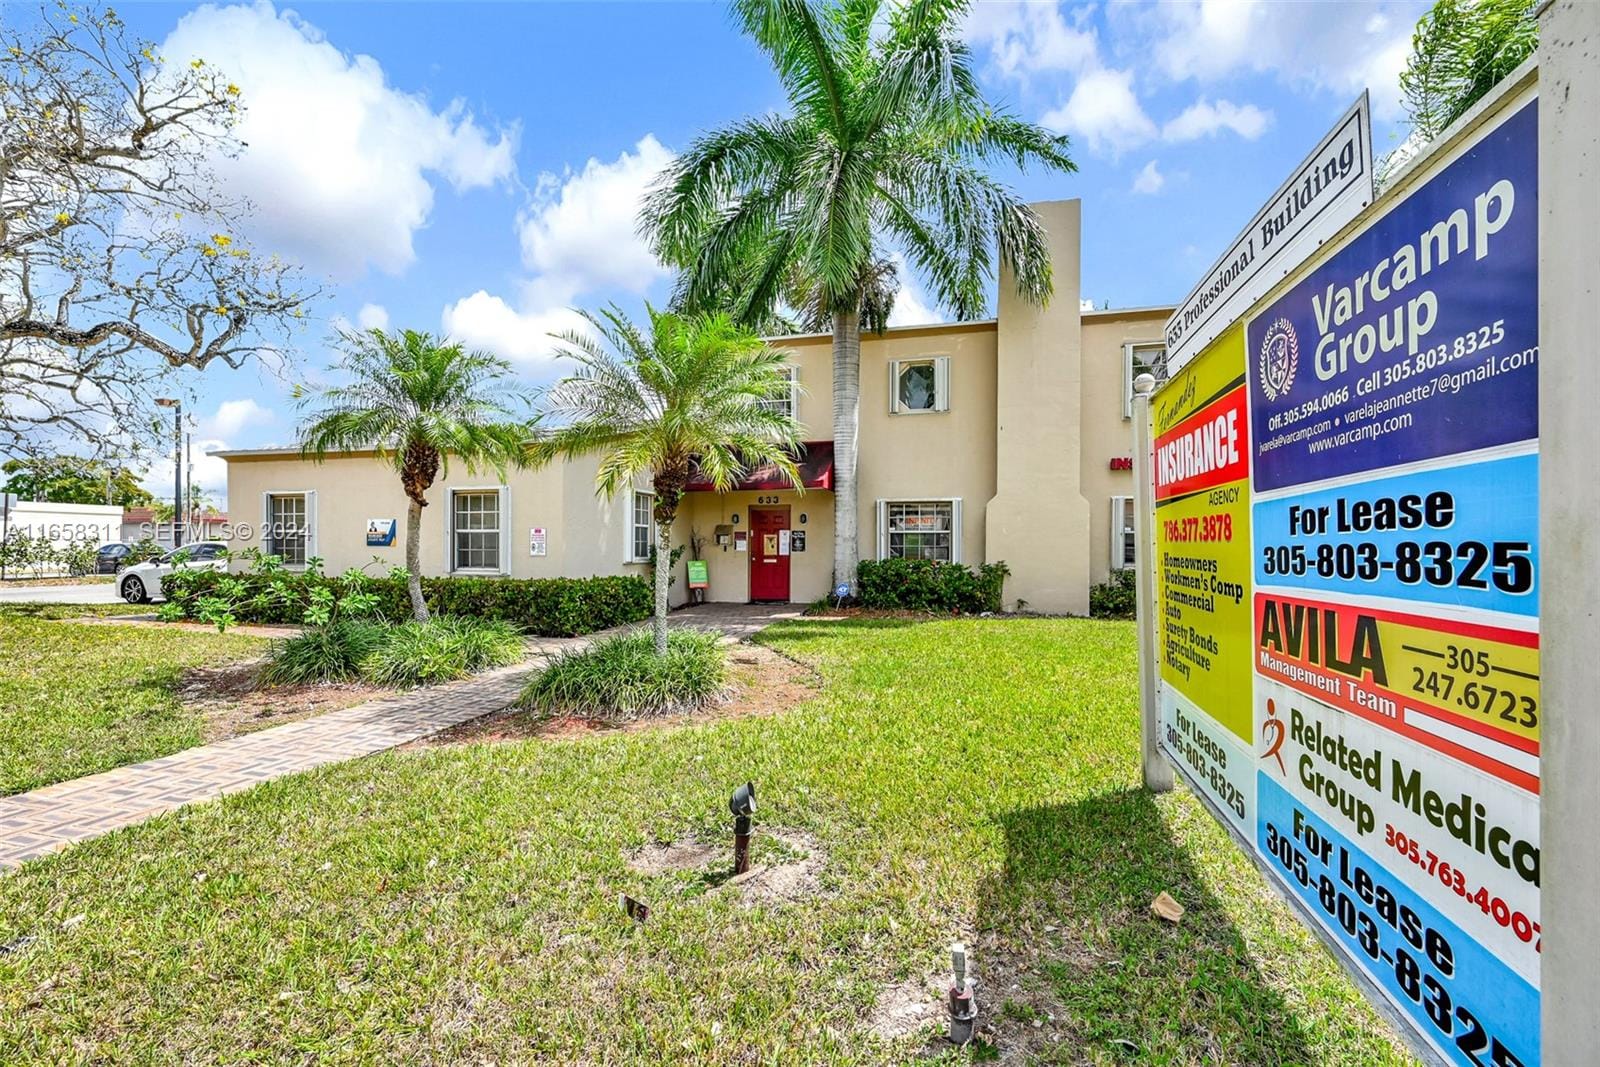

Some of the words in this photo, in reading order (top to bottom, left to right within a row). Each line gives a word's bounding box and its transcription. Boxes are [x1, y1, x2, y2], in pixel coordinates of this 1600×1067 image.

[1184, 238, 1255, 331] Professional
[1261, 138, 1354, 251] Building
[1312, 179, 1514, 336] Varcamp
[1314, 290, 1438, 381] Group
[1356, 370, 1380, 397] Cell
[1383, 319, 1505, 387] 305.803.8325
[1259, 420, 1331, 456] jvarela@varcamp.com
[1344, 346, 1539, 424] varelajeannette7@gmail.com
[1158, 408, 1239, 487] INSURANCE
[1308, 412, 1413, 454] www.varcamp.com
[758, 496, 779, 504] 633
[1208, 487, 1240, 506] AGENCY
[1289, 505, 1329, 536] For
[1336, 491, 1455, 534] Lease
[1163, 513, 1233, 544] 786.377.3878
[1164, 552, 1217, 573] Homeowners
[1164, 569, 1208, 591] Workmen's
[1210, 575, 1243, 604] Comp
[1263, 540, 1533, 595] 305-803-8325
[1165, 585, 1215, 613] Commercial
[1165, 601, 1181, 620] Auto
[1165, 617, 1188, 645] Surety
[1189, 626, 1218, 655] Bonds
[1166, 634, 1211, 671] Agriculture
[1260, 599, 1389, 688] AVILA
[1446, 645, 1490, 677] 305
[1166, 649, 1191, 682] Notary
[1259, 651, 1341, 697] Management
[1346, 681, 1397, 719] Team
[1412, 667, 1538, 729] 247.6723
[1176, 708, 1191, 736] For
[1193, 721, 1227, 770] Lease
[1166, 723, 1245, 820] 305-803-8325
[1290, 708, 1382, 793] Related
[1391, 758, 1540, 888] Medica
[1299, 753, 1375, 837] Group
[1293, 808, 1333, 867] For
[1339, 846, 1456, 979] Lease
